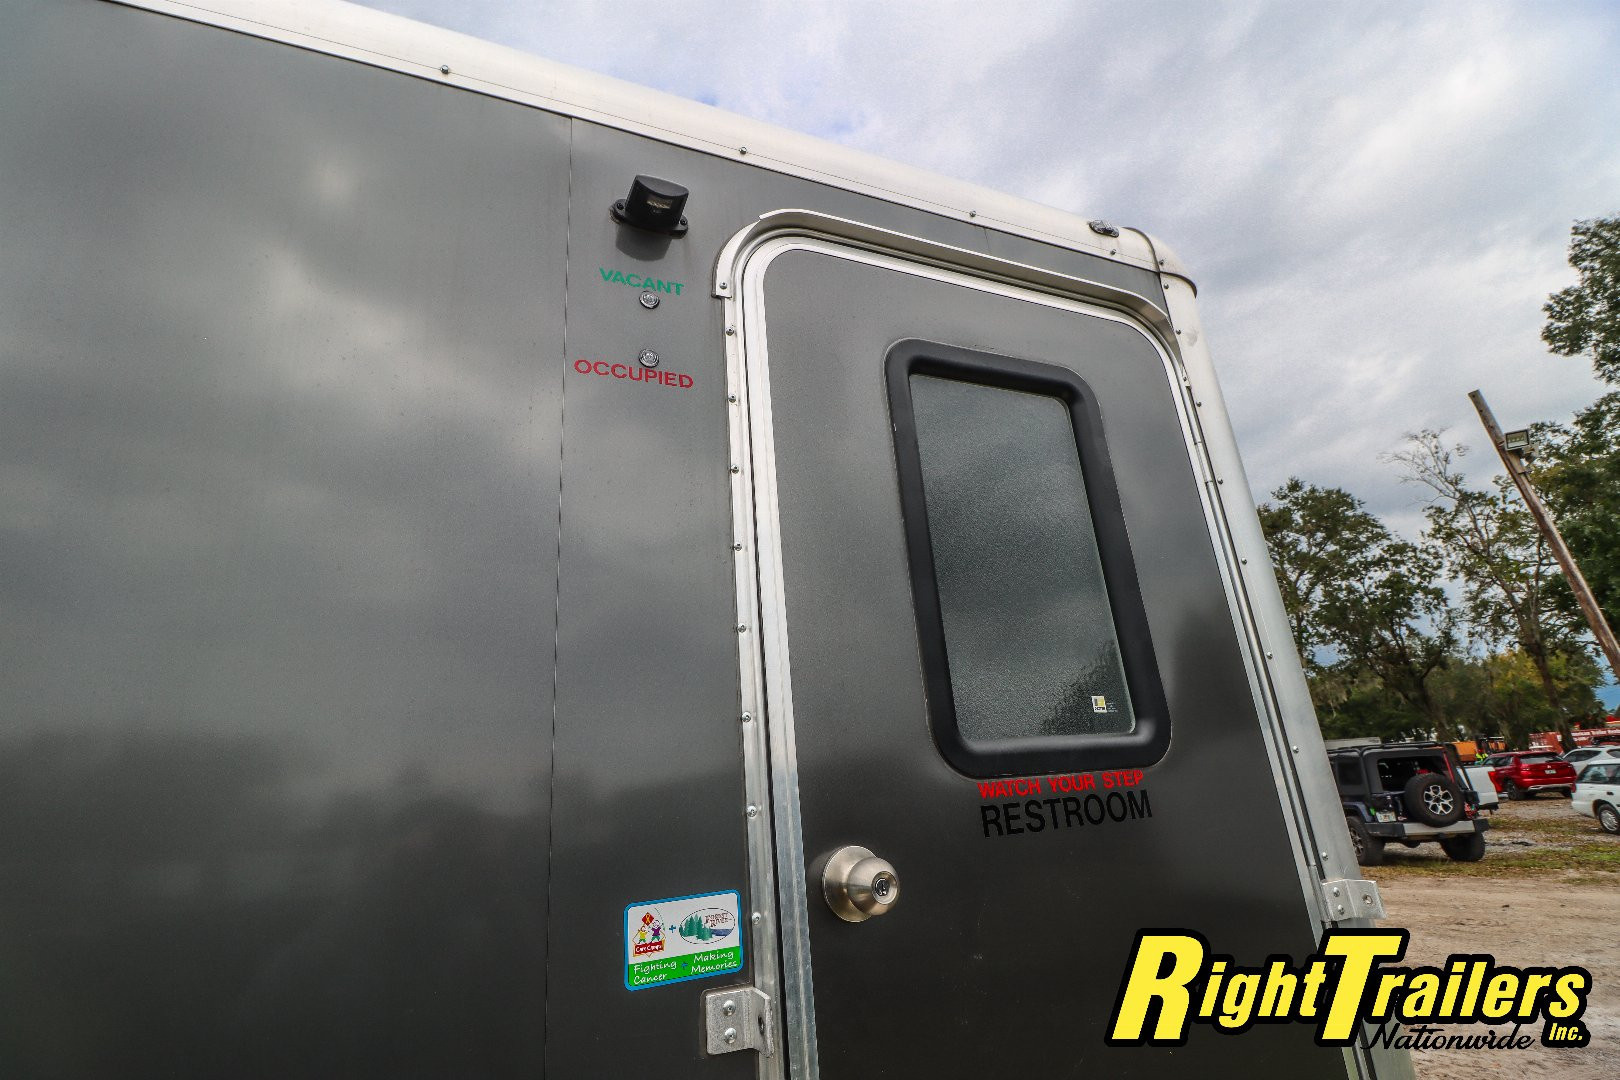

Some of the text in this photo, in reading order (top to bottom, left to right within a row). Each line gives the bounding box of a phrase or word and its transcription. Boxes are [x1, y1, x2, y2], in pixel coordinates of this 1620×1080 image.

[599, 266, 685, 296] VACANT
[573, 359, 694, 389] OCCUPIED
[977, 769, 1144, 800] WATCH YOUR STEP
[980, 789, 1153, 838] RESTROOM
[633, 960, 677, 975] Fighting
[690, 960, 738, 975] Memories
[693, 951, 734, 964] Making
[633, 973, 668, 985] Cancer
